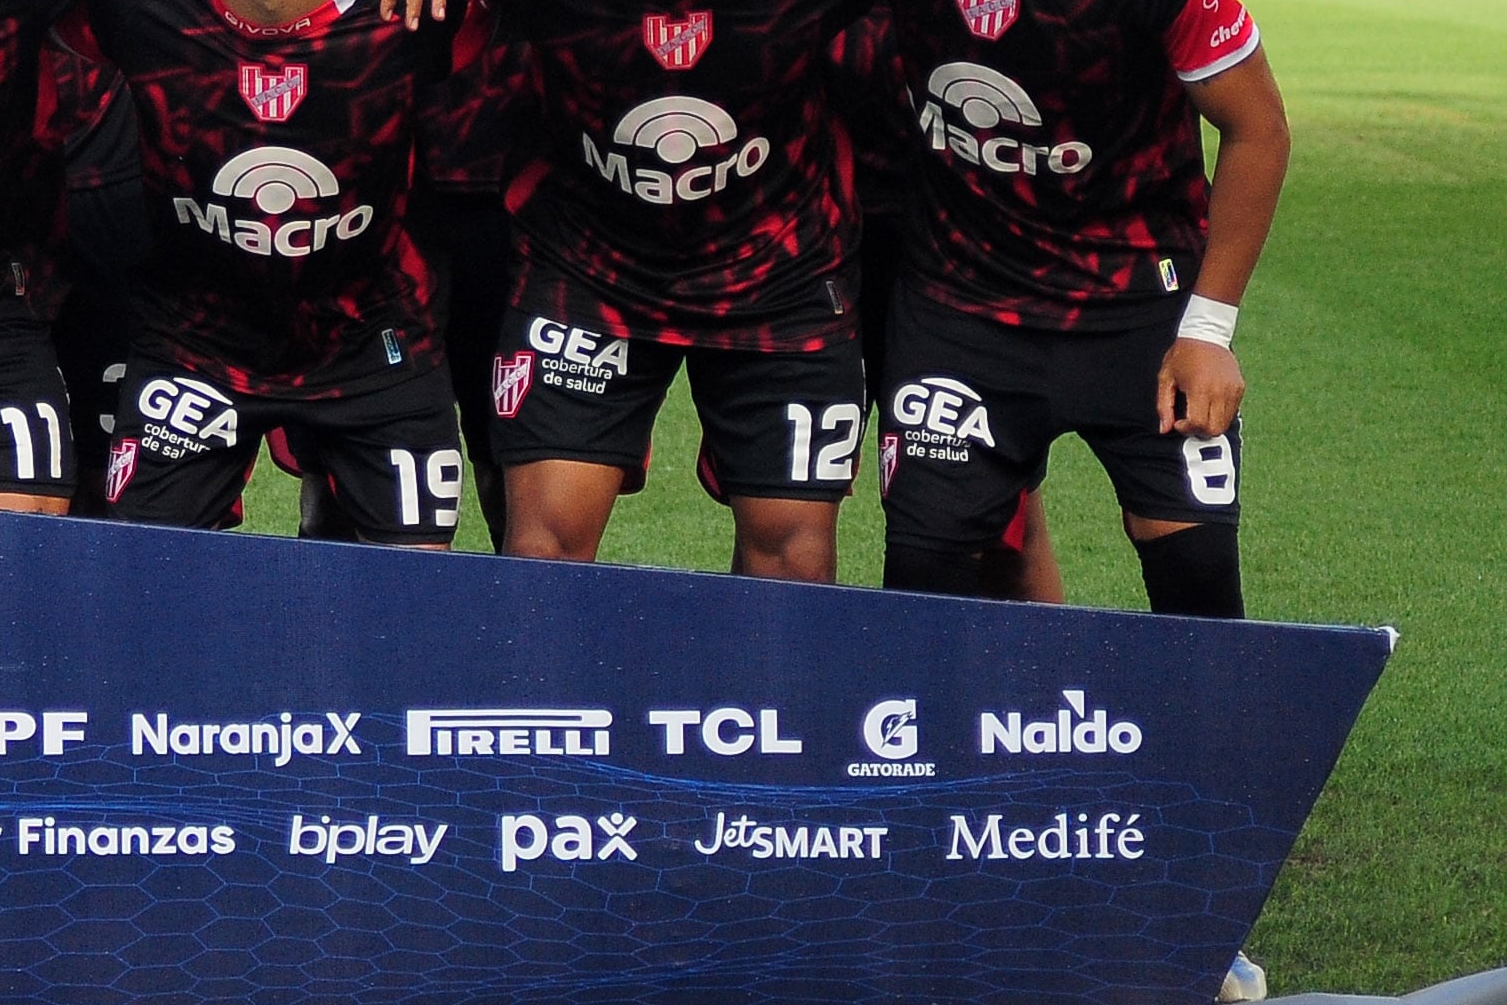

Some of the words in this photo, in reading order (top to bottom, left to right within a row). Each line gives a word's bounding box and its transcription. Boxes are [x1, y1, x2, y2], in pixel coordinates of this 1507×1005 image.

[224, 10, 312, 37] GIVOVA
[906, 83, 1094, 177] Macro
[582, 131, 771, 205] Macro
[173, 196, 375, 258] Macro
[528, 316, 628, 375] GEA
[542, 357, 613, 381] cobertura
[543, 372, 564, 387] de
[567, 375, 607, 395] salud
[0, 401, 62, 480] 11
[138, 379, 239, 448] GEA
[893, 383, 995, 448] GEA
[140, 435, 168, 452] de
[787, 402, 861, 482] 12
[906, 443, 925, 458] de
[928, 447, 970, 463] salud
[391, 449, 463, 527] 19
[132, 713, 361, 767] NaranjaX
[407, 709, 613, 755] PIRELLI
[649, 708, 802, 755] TCL
[981, 690, 1143, 754] Naldo
[847, 763, 935, 777] GATORADE
[18, 817, 236, 856] Finanzas
[501, 812, 638, 872] pax
[694, 812, 889, 859] JetSMART
[946, 813, 1145, 860] Medifé
